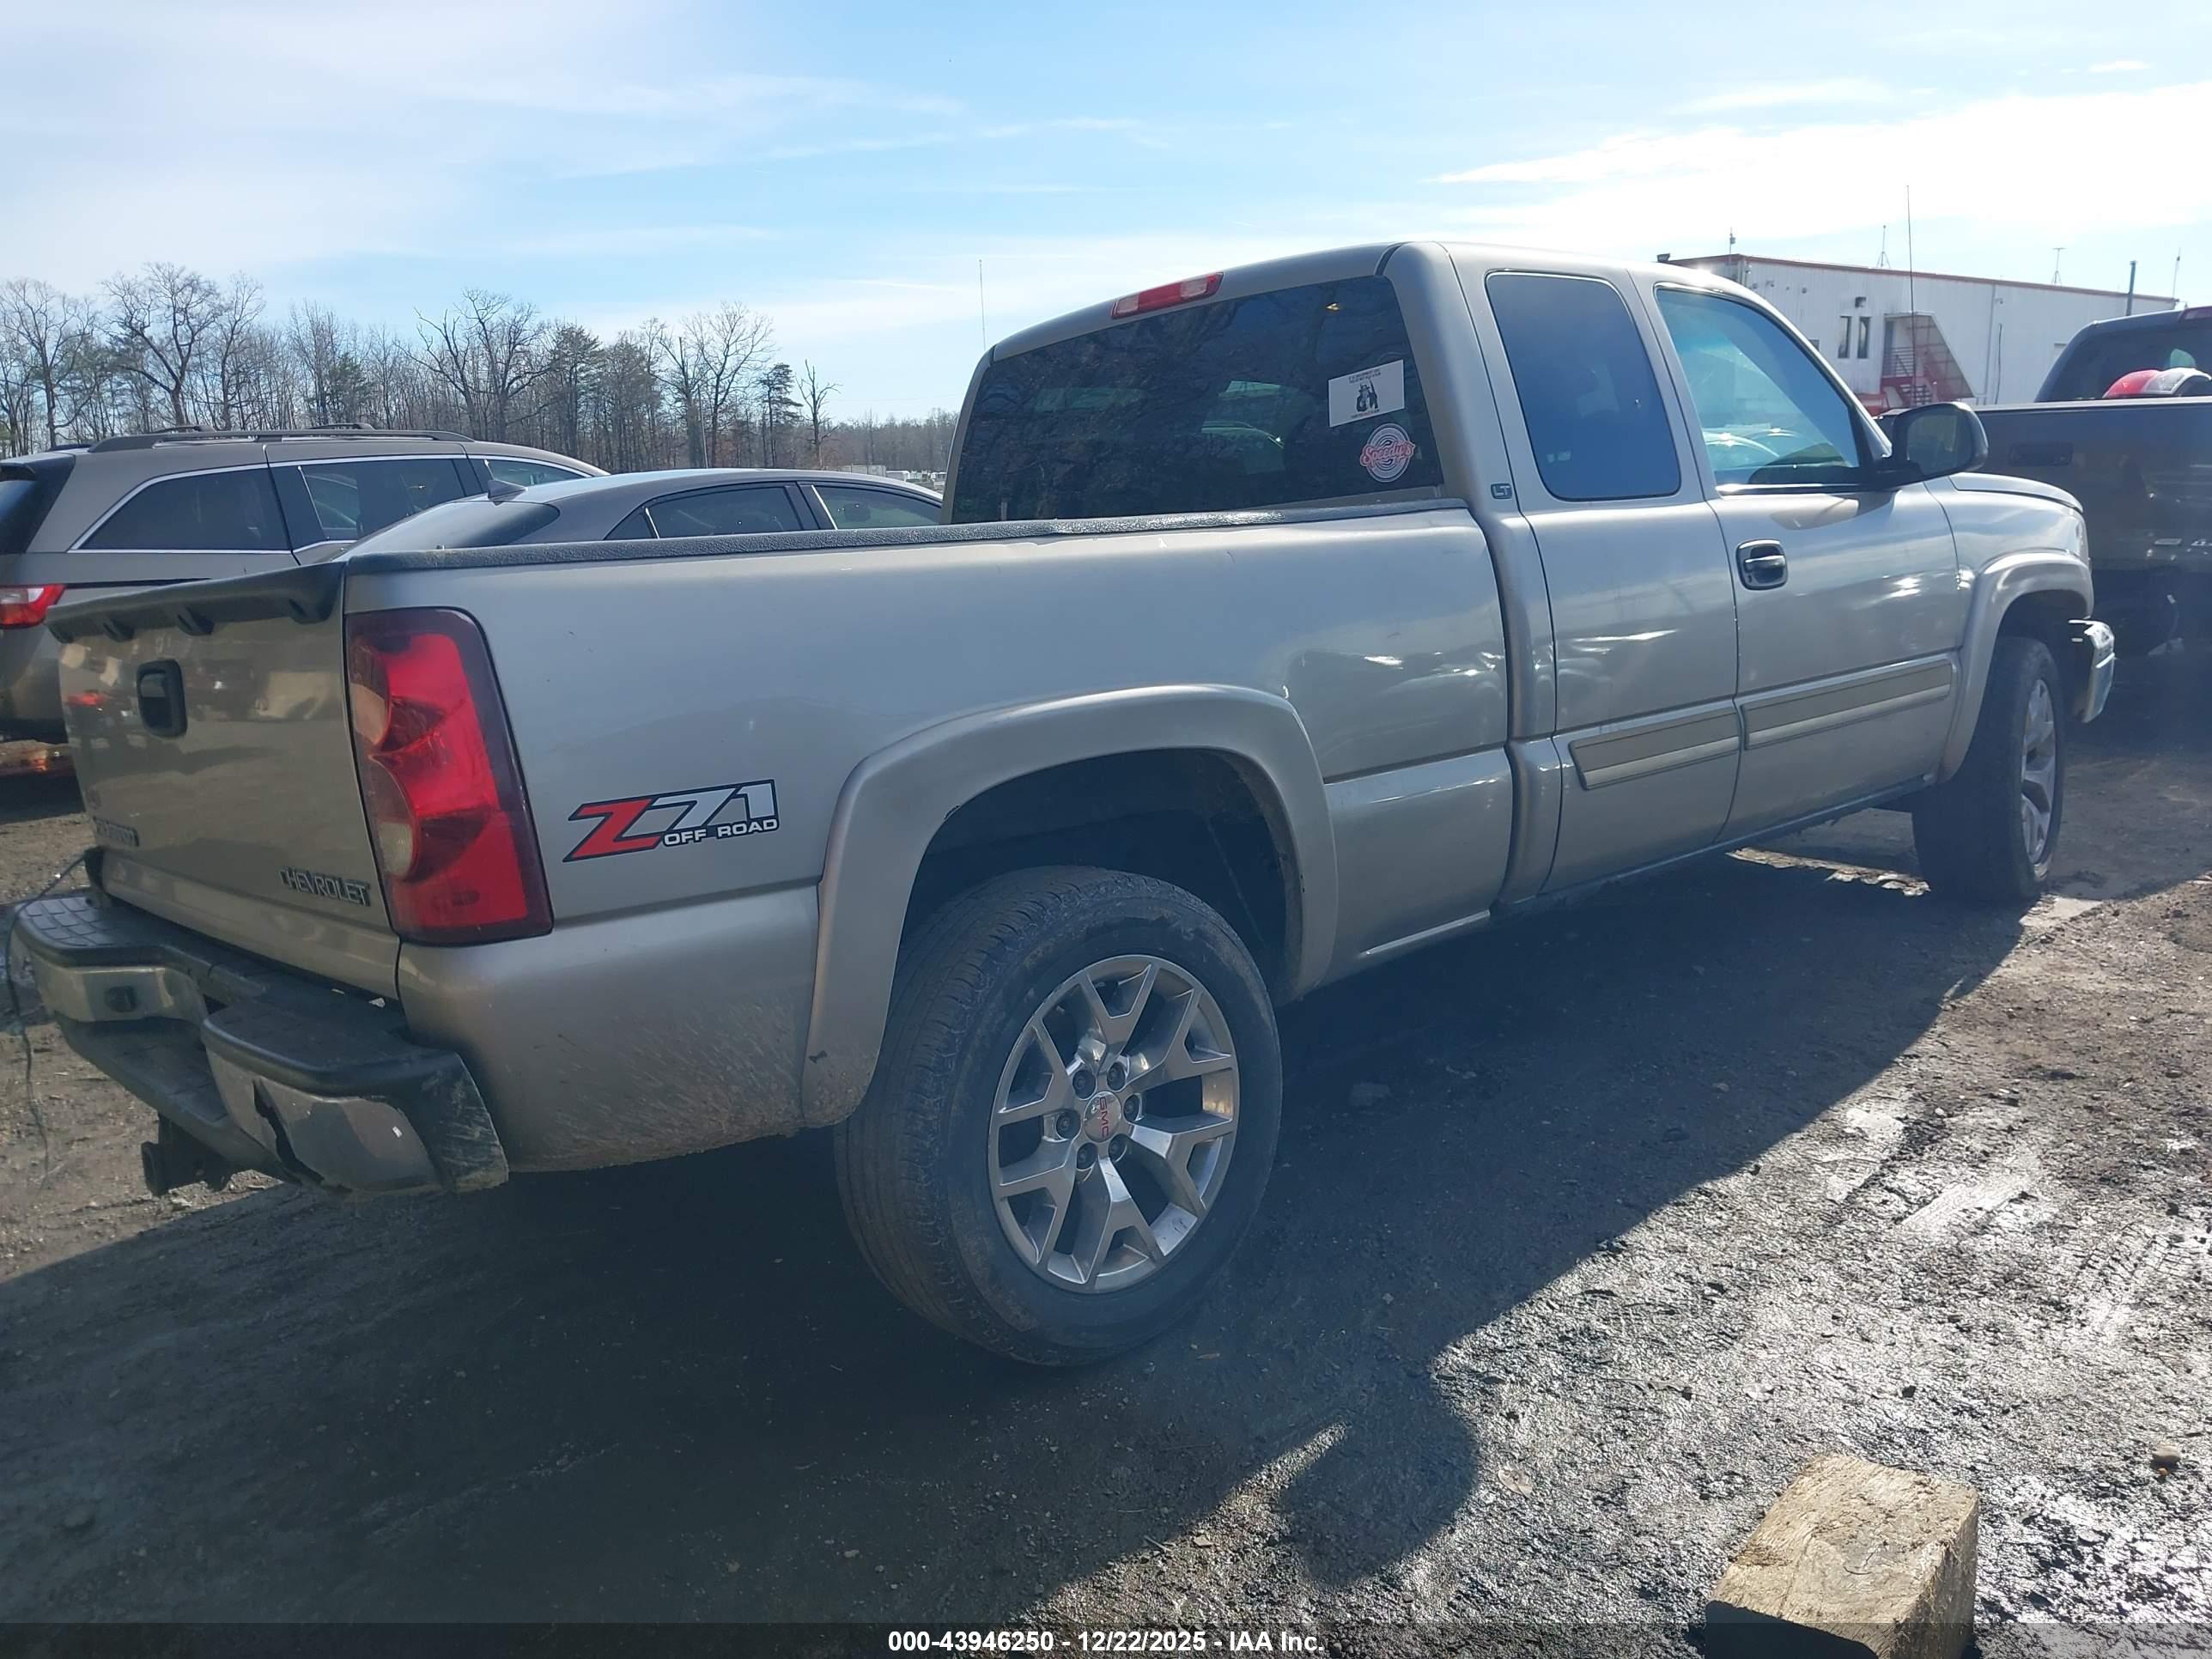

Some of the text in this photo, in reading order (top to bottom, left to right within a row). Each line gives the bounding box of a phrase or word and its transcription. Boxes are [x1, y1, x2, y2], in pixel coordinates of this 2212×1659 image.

[562, 779, 779, 862] Z71
[664, 818, 778, 846] OFF ROAD
[279, 867, 369, 906] CHEVROLET
[1099, 1097, 1109, 1138] GMC
